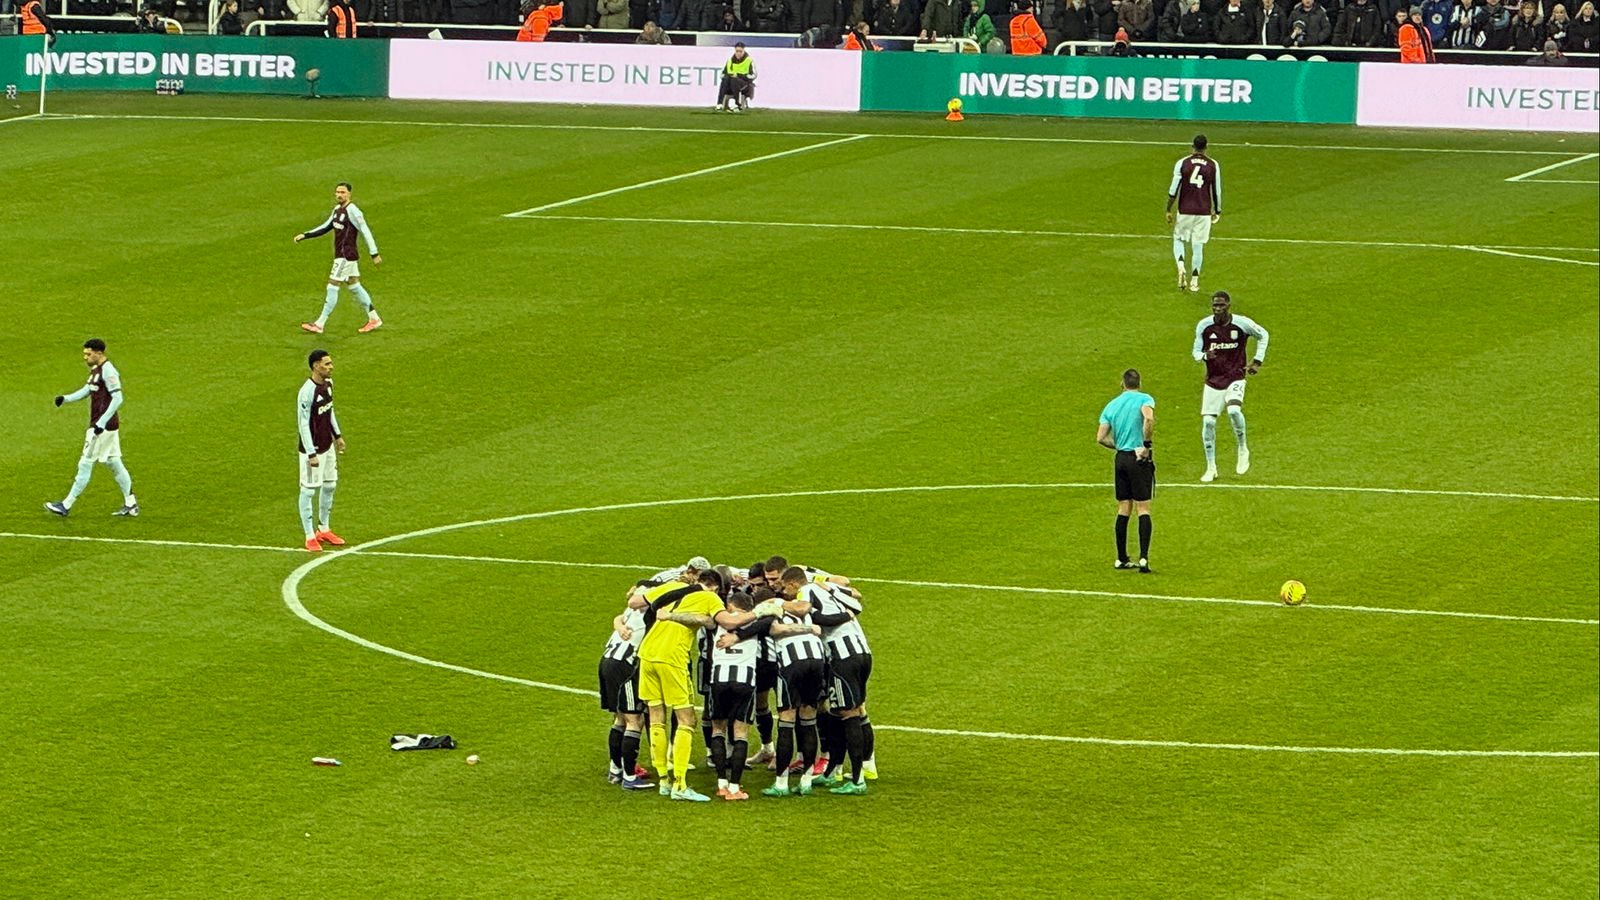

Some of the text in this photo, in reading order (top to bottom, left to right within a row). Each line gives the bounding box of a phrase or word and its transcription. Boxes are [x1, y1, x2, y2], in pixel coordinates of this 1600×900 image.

[25, 51, 296, 78] INVESTED IN BETTER
[487, 61, 723, 86] INVESTED IN BETT
[959, 72, 1252, 103] INVESTED IN BETTER
[1189, 165, 1205, 189] 4
